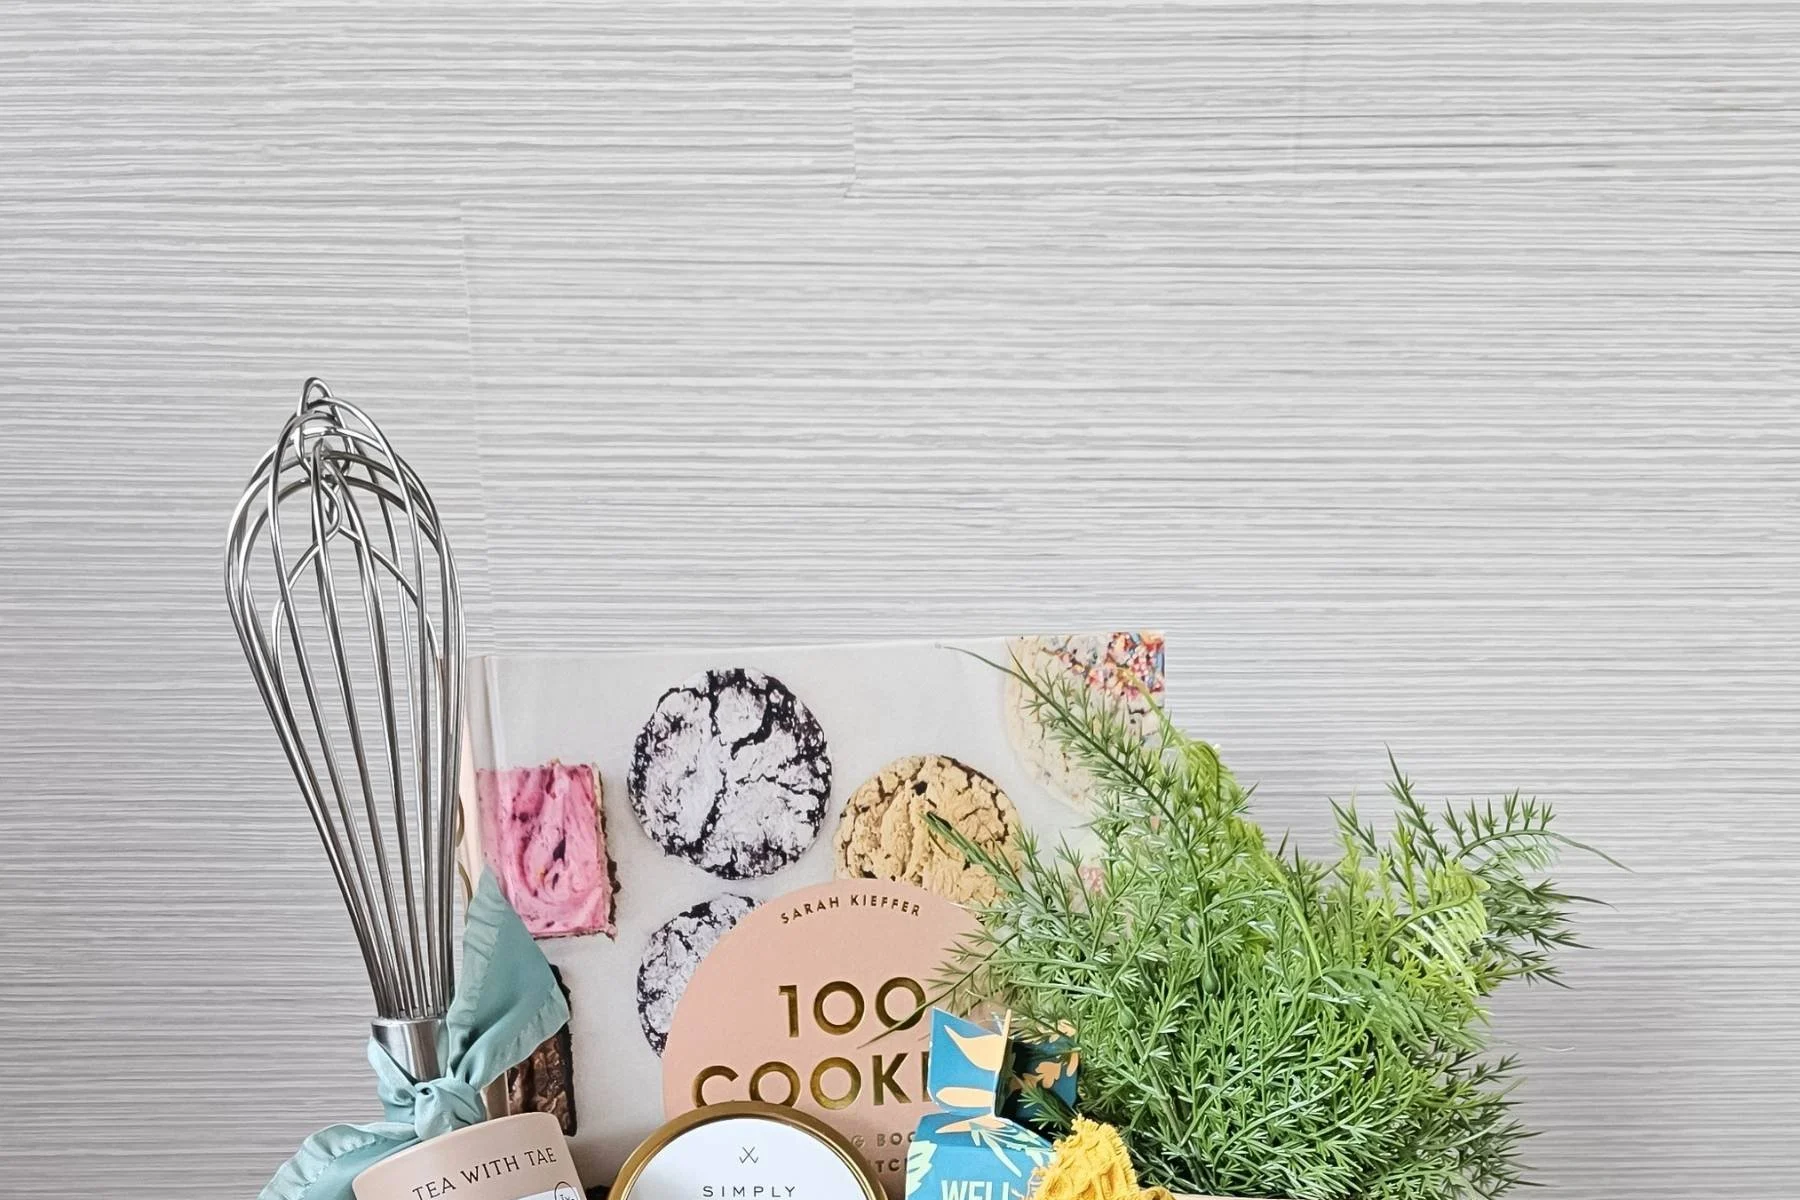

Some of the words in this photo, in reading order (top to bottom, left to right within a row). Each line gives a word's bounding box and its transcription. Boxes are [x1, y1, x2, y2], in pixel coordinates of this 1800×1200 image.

[780, 896, 840, 924] SARAH
[850, 894, 920, 917] KIEFFER
[778, 976, 926, 1038] 100
[460, 1155, 520, 1184] WITH
[524, 1148, 557, 1166] TAE
[703, 1185, 795, 1198] SIMPLY
